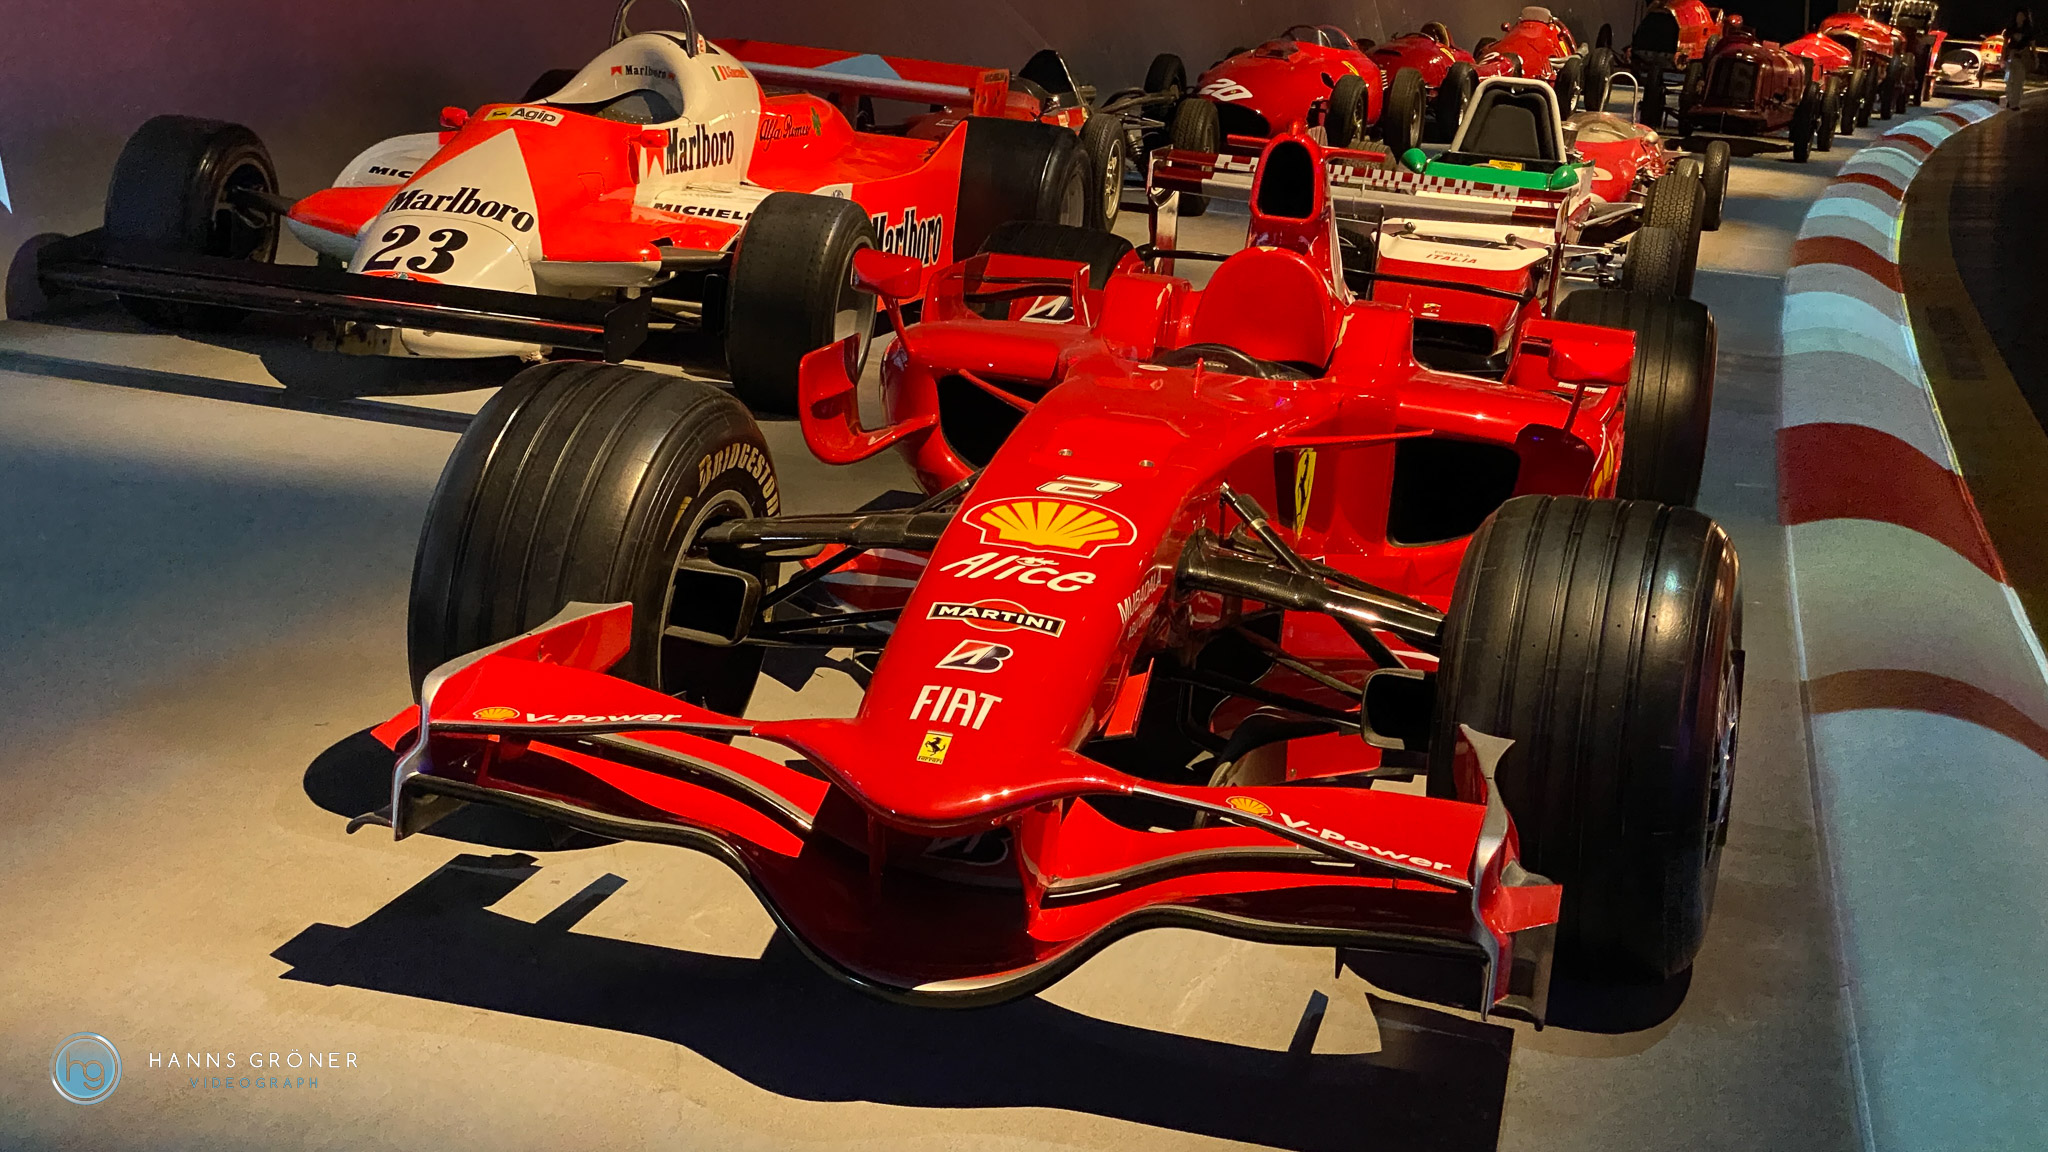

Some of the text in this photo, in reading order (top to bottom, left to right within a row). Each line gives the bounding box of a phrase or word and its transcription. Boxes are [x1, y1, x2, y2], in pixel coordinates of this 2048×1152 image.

[625, 65, 667, 78] Marlboro
[1198, 78, 1254, 101] 20
[511, 107, 556, 123] Agip
[665, 123, 735, 175] Marlboro
[759, 118, 781, 152] Alfa
[383, 187, 534, 232] Marlboro
[653, 203, 753, 221] MICHELI
[361, 224, 469, 274] 23
[1425, 253, 1477, 264] ITALIA
[698, 442, 781, 518] BRIDGESTON
[1036, 475, 1122, 500] 2
[939, 552, 1097, 592] Alice
[1117, 569, 1162, 625] MUBADALA
[938, 606, 1054, 631] MARTINI
[526, 713, 682, 723] V-Power
[909, 685, 1003, 730] FIAT
[1280, 812, 1452, 870] V-Power
